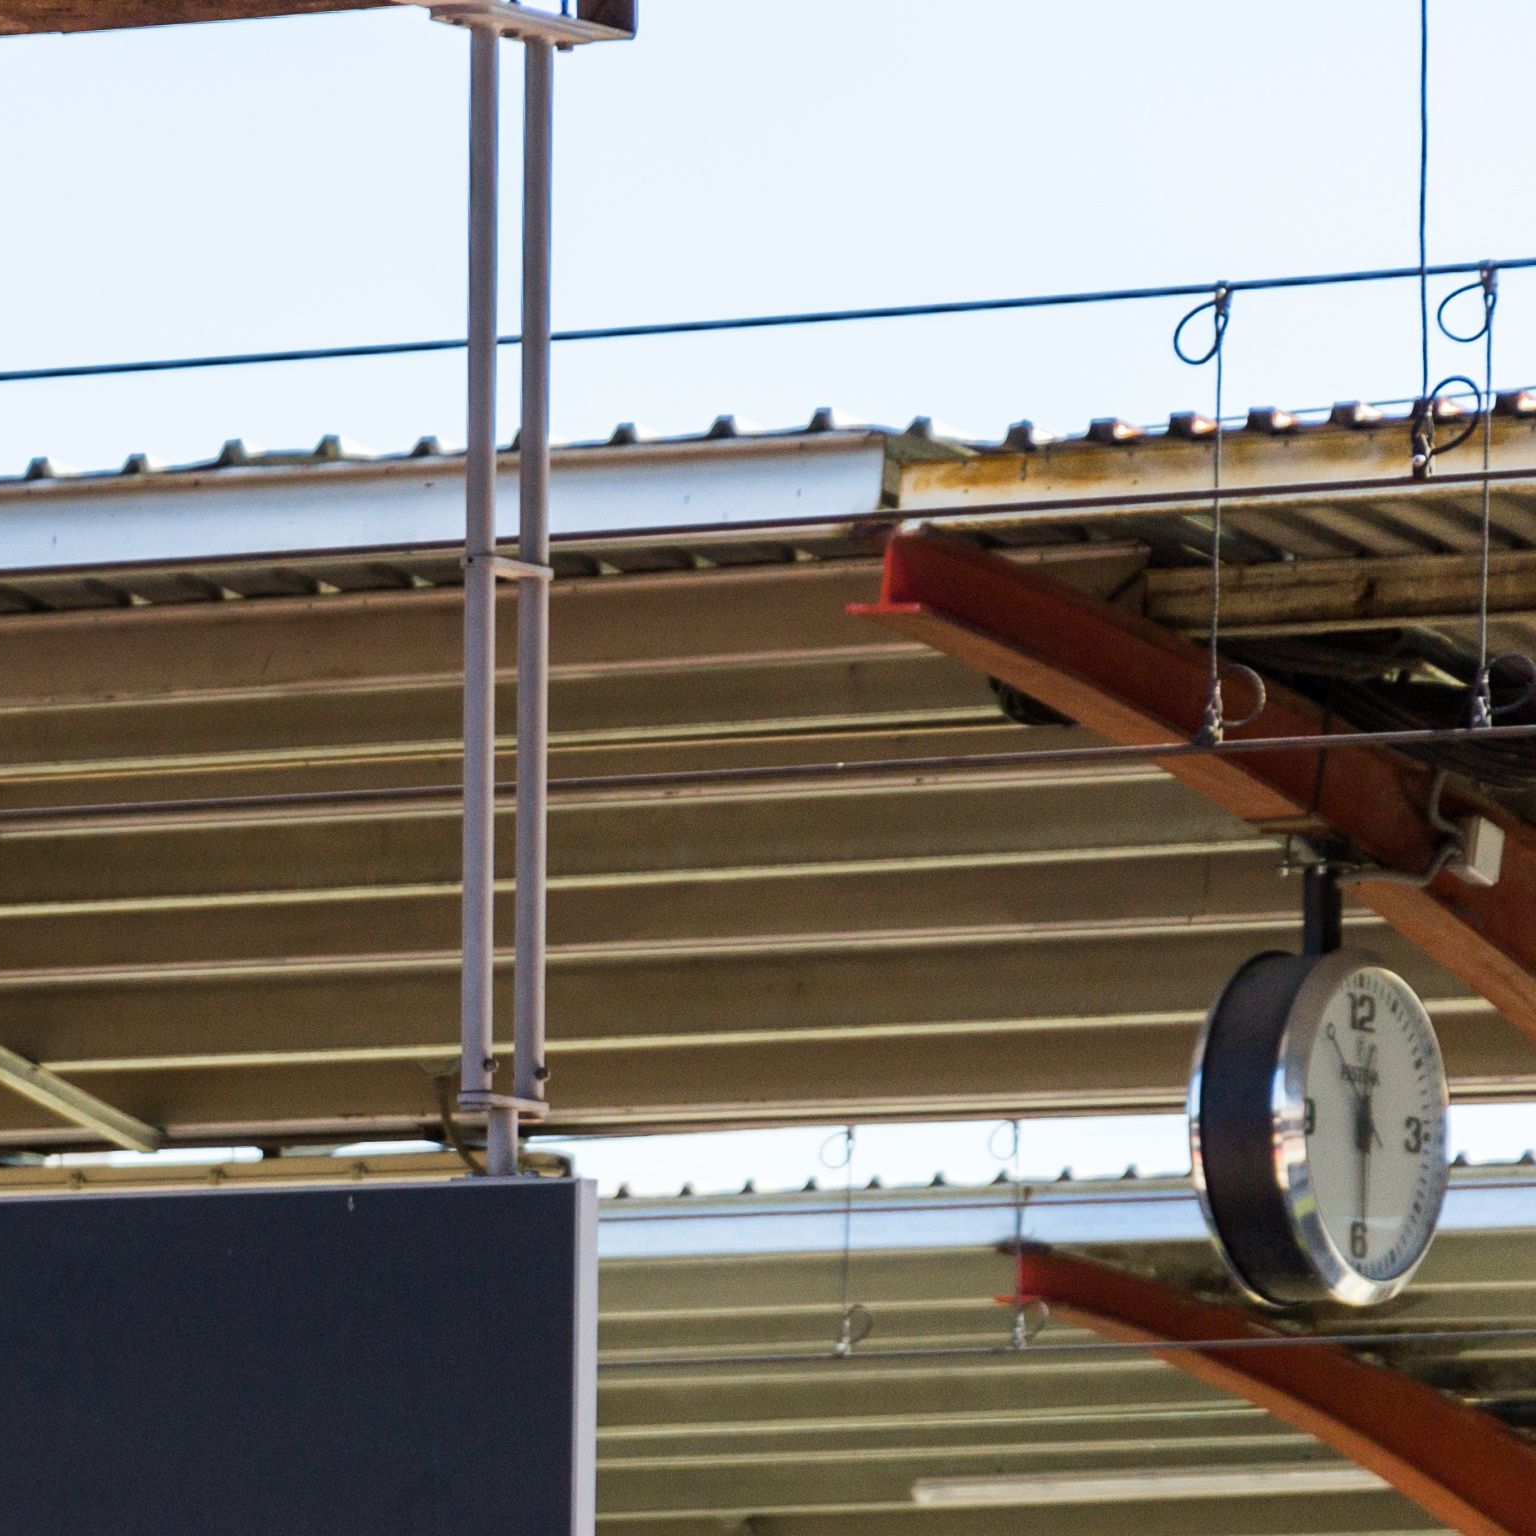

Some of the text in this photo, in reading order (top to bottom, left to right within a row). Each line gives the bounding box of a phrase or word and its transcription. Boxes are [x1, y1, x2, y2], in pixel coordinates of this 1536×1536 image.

[1348, 992, 1375, 1032] 12
[1404, 1117, 1423, 1153] 3
[1350, 1221, 1368, 1260] 6
